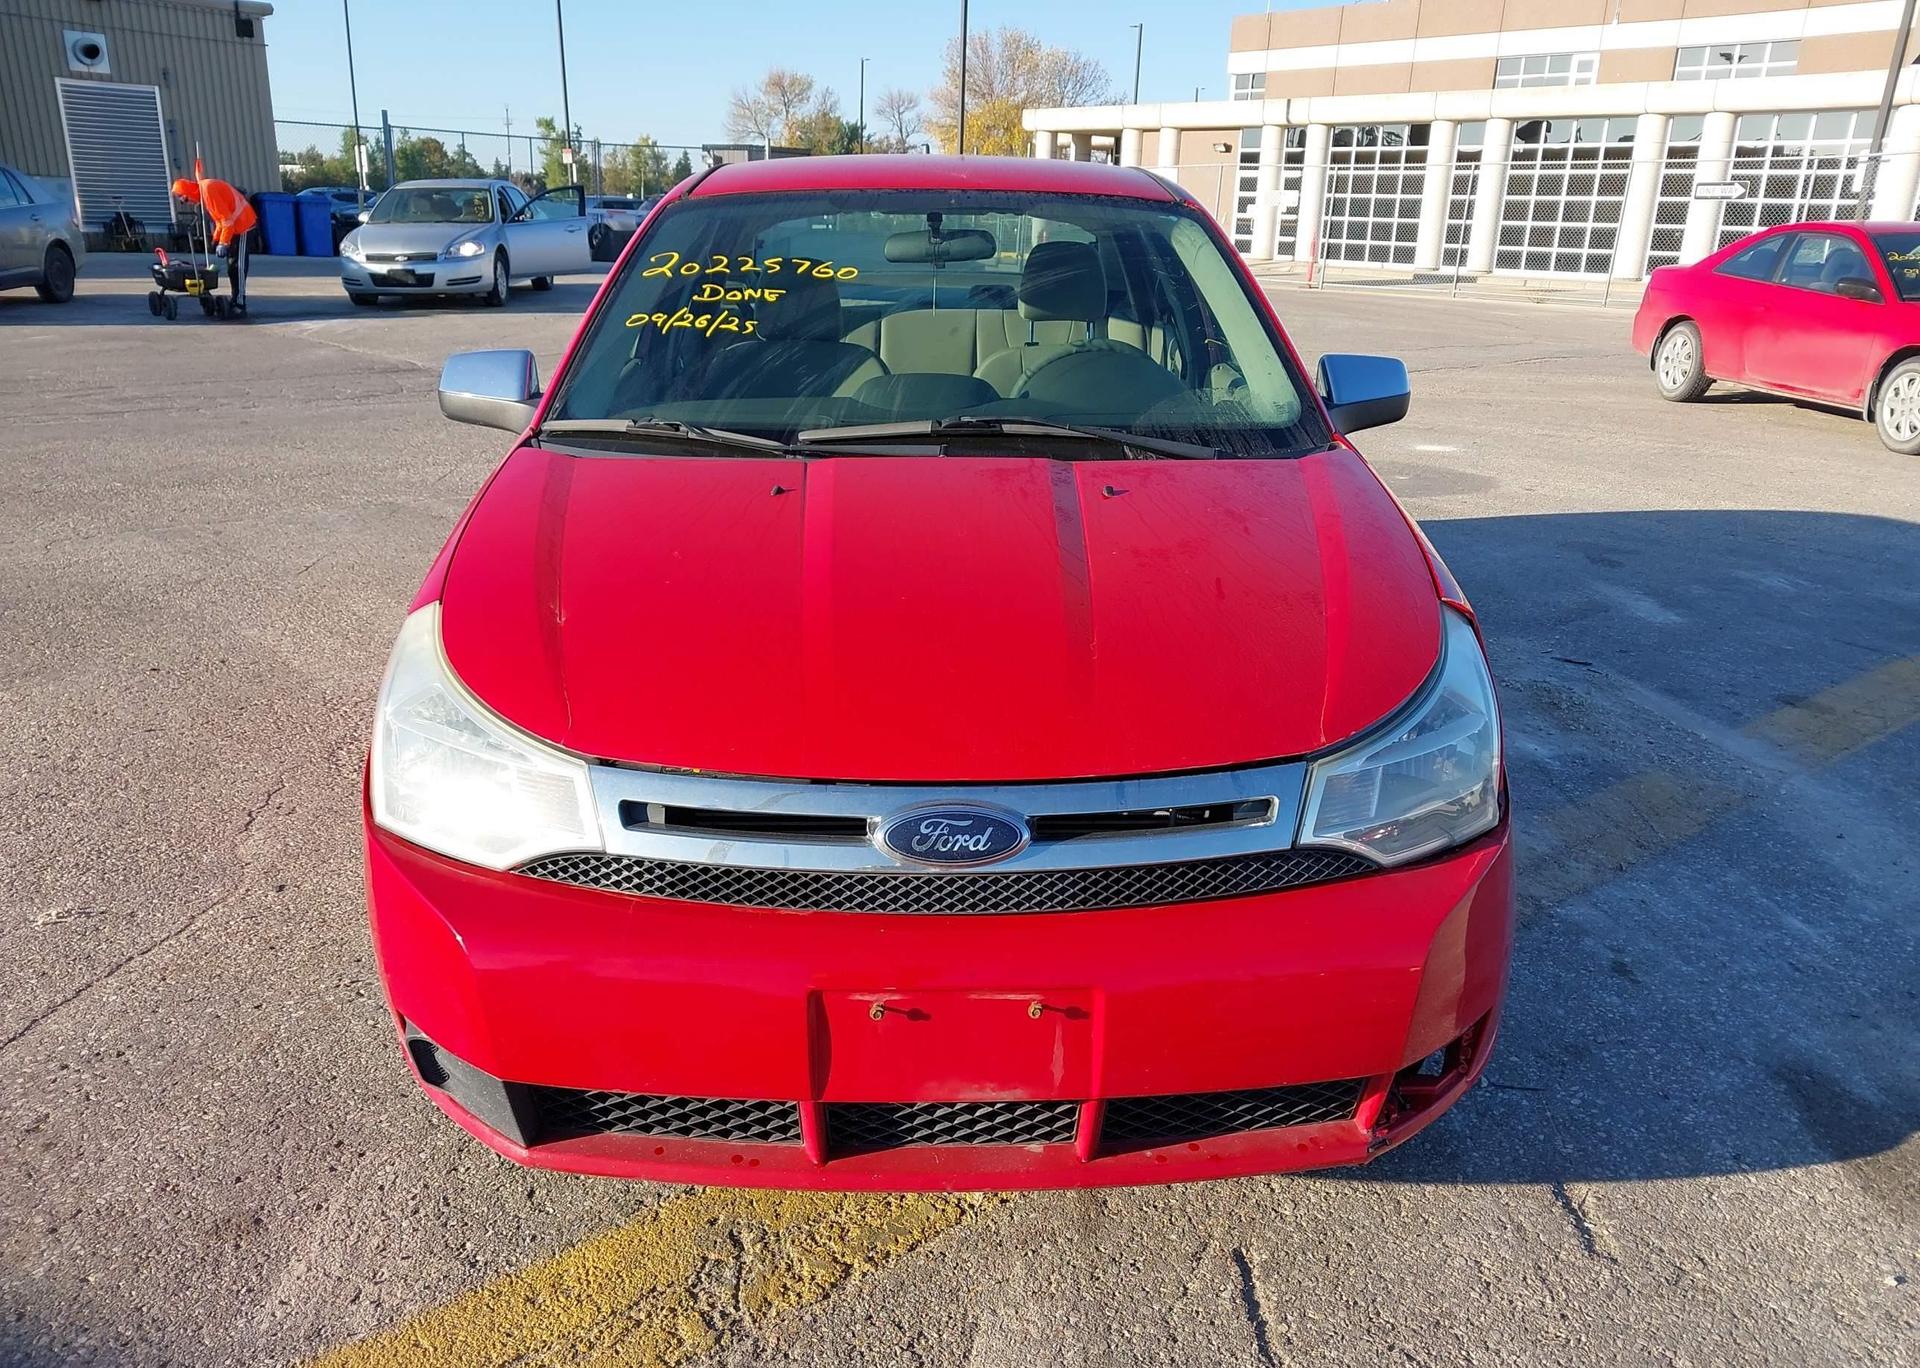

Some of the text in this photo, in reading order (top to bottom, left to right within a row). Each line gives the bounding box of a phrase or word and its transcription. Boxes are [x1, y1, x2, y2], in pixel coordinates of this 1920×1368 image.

[642, 251, 858, 279] 20225760
[625, 306, 758, 337] 09/26/25
[911, 818, 994, 851] Ford
